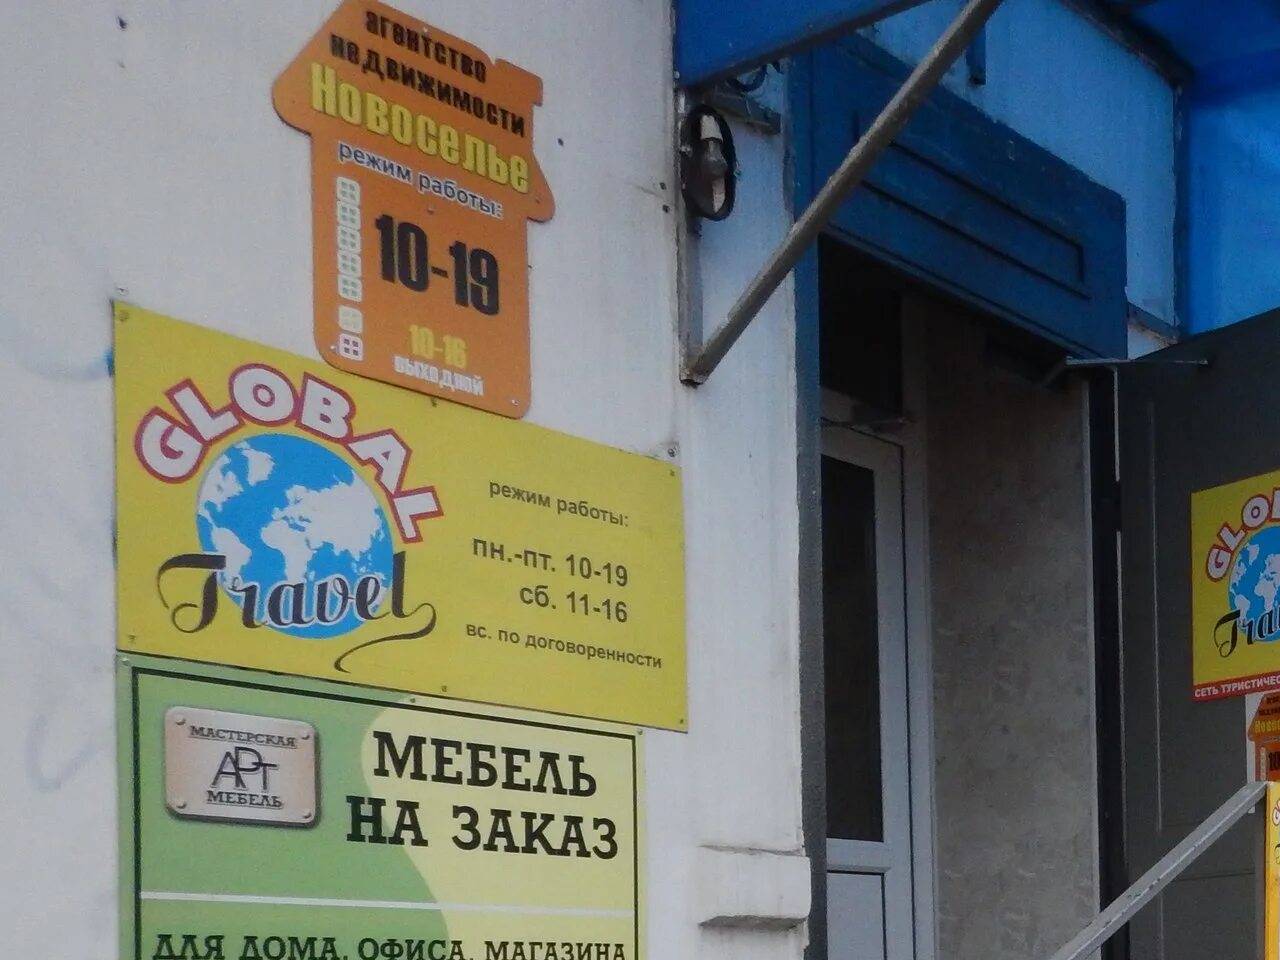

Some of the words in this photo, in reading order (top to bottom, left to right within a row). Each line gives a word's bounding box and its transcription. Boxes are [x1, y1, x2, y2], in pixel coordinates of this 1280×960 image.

[366, 9, 487, 84] агентство
[330, 33, 525, 138] недвижимости
[311, 61, 530, 195] Новоселье
[338, 141, 412, 185] режим
[418, 171, 504, 219] работы:
[375, 213, 500, 317] 10-19
[408, 323, 468, 369] 10-16
[134, 362, 445, 544] GLOBAL
[489, 478, 551, 510] режим
[556, 493, 629, 528] работы:
[472, 537, 556, 573] пн.-пт.
[565, 554, 629, 587] 10-19
[157, 550, 438, 674] Travel
[519, 583, 557, 611] сб.
[566, 593, 628, 624] 11-16
[466, 621, 493, 642] вс.
[498, 627, 521, 646] по
[525, 632, 662, 669] договоренности
[1194, 686, 1219, 698] СЕТЬ
[190, 724, 298, 749] МАСТЕРСКАЯ
[372, 731, 597, 798] МЕБЕЛЬ
[212, 745, 278, 791] АРТ
[206, 789, 283, 809] МЕБЕЛЬ
[346, 796, 428, 847] НА
[452, 804, 618, 861] ЗАКАЗ
